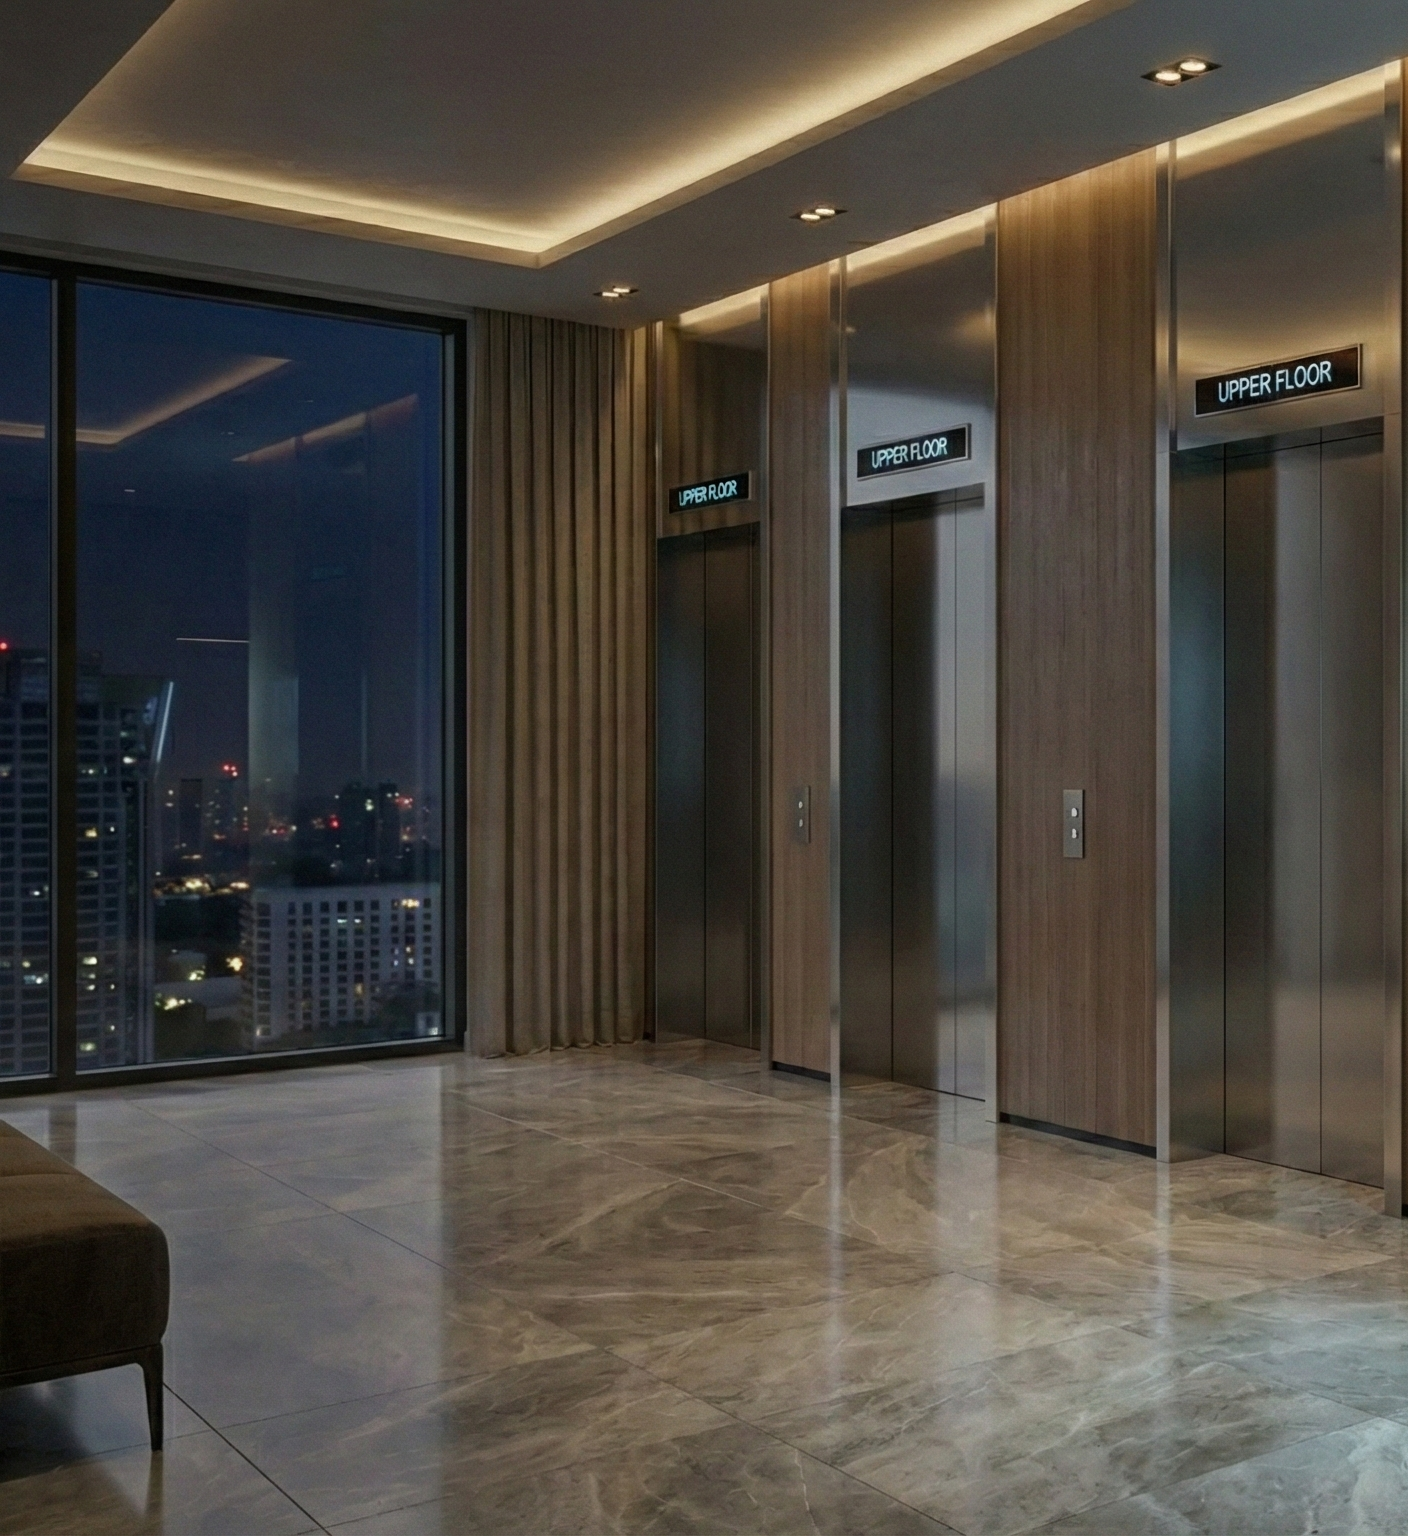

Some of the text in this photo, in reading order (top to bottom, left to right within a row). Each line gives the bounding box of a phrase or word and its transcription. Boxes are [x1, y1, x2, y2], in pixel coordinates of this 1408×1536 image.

[1218, 360, 1332, 403] UPPER FLOOR
[871, 437, 948, 469] UPPER FLOOR
